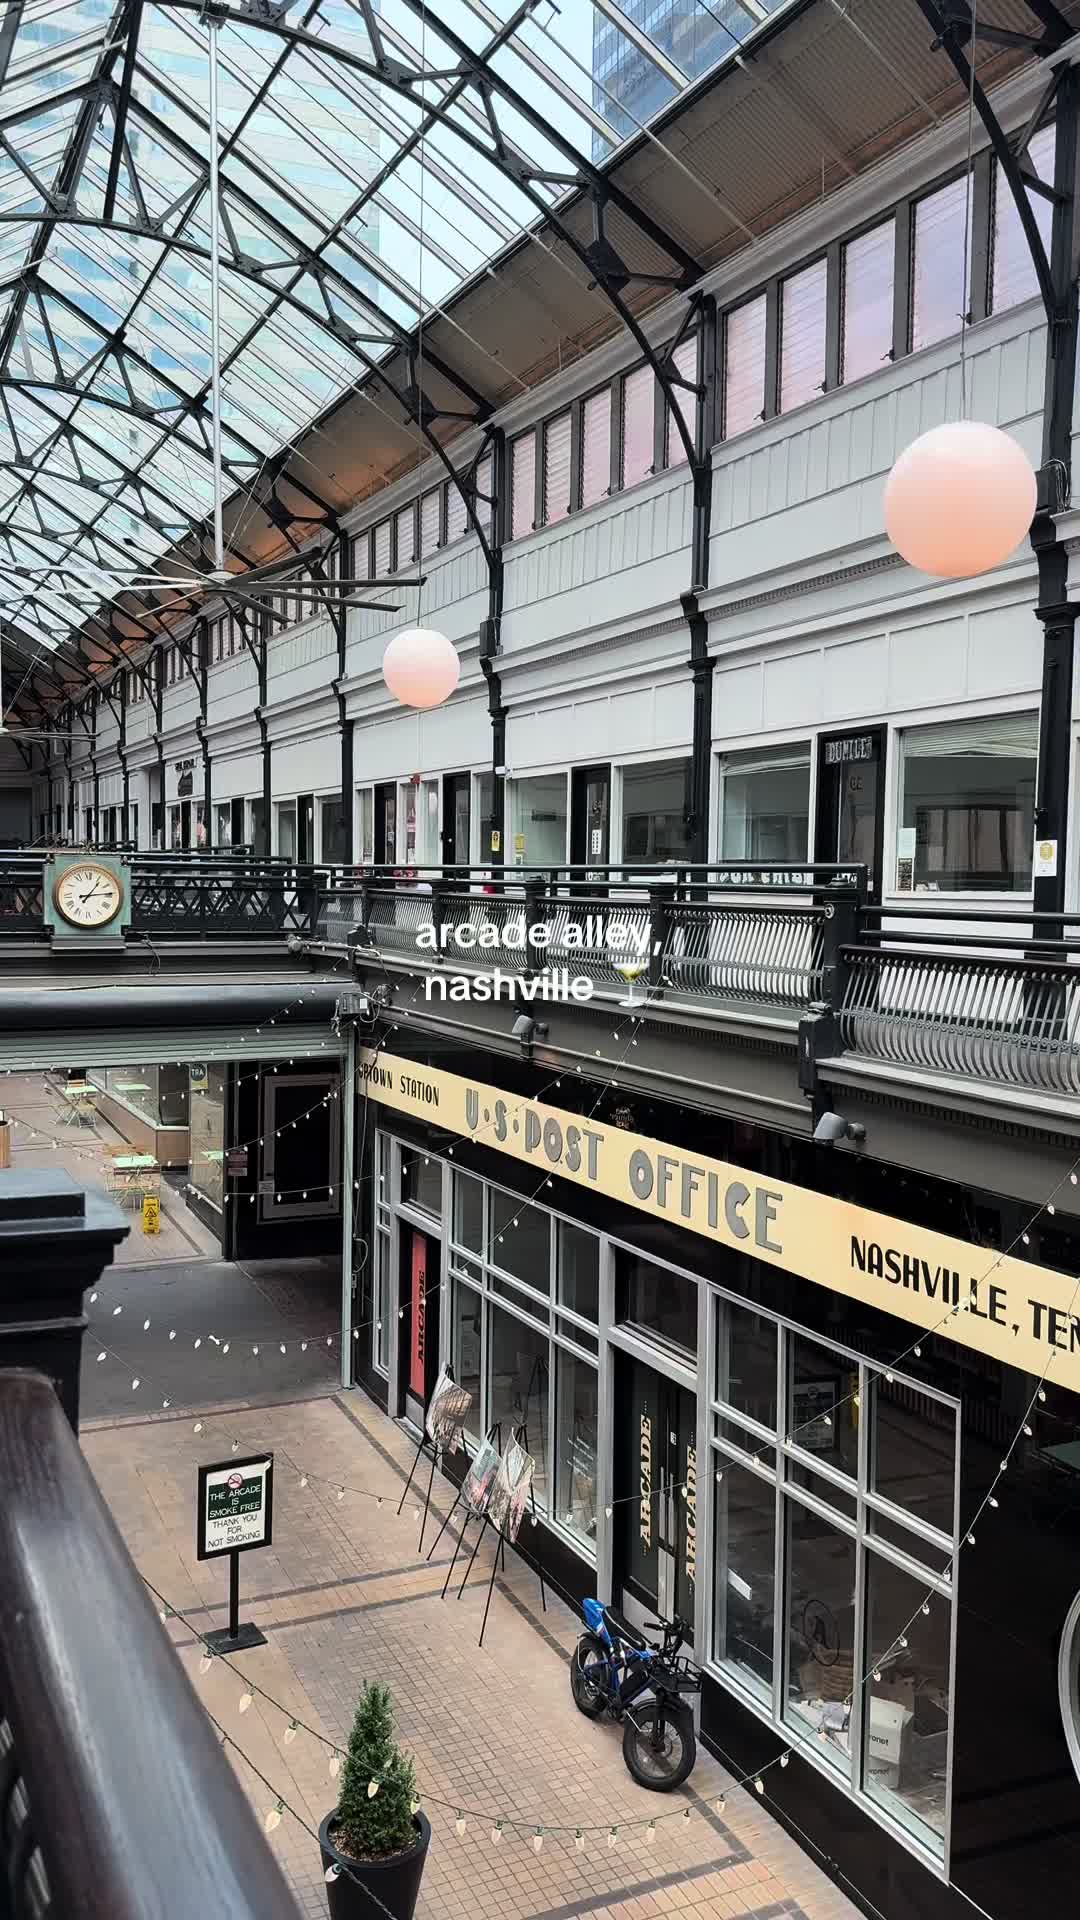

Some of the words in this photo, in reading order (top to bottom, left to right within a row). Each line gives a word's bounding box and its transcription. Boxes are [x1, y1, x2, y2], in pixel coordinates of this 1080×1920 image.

[400, 1075, 439, 1106] STATION
[629, 1148, 783, 1254] OFFICE
[851, 1235, 1020, 1336] NASHVILLE,
[640, 1414, 651, 1549] ARCADE
[210, 1491, 226, 1501] THE
[229, 1484, 261, 1497] ARCADE
[231, 1497, 239, 1505] IS
[209, 1506, 238, 1518] SMOKE
[240, 1501, 260, 1512] FREE
[685, 1445, 697, 1583] ARCADE
[213, 1517, 240, 1529] THANK
[242, 1514, 257, 1523] YOU
[227, 1525, 242, 1535] FOR
[208, 1538, 223, 1548] NOT
[226, 1530, 261, 1544] SMOKING
